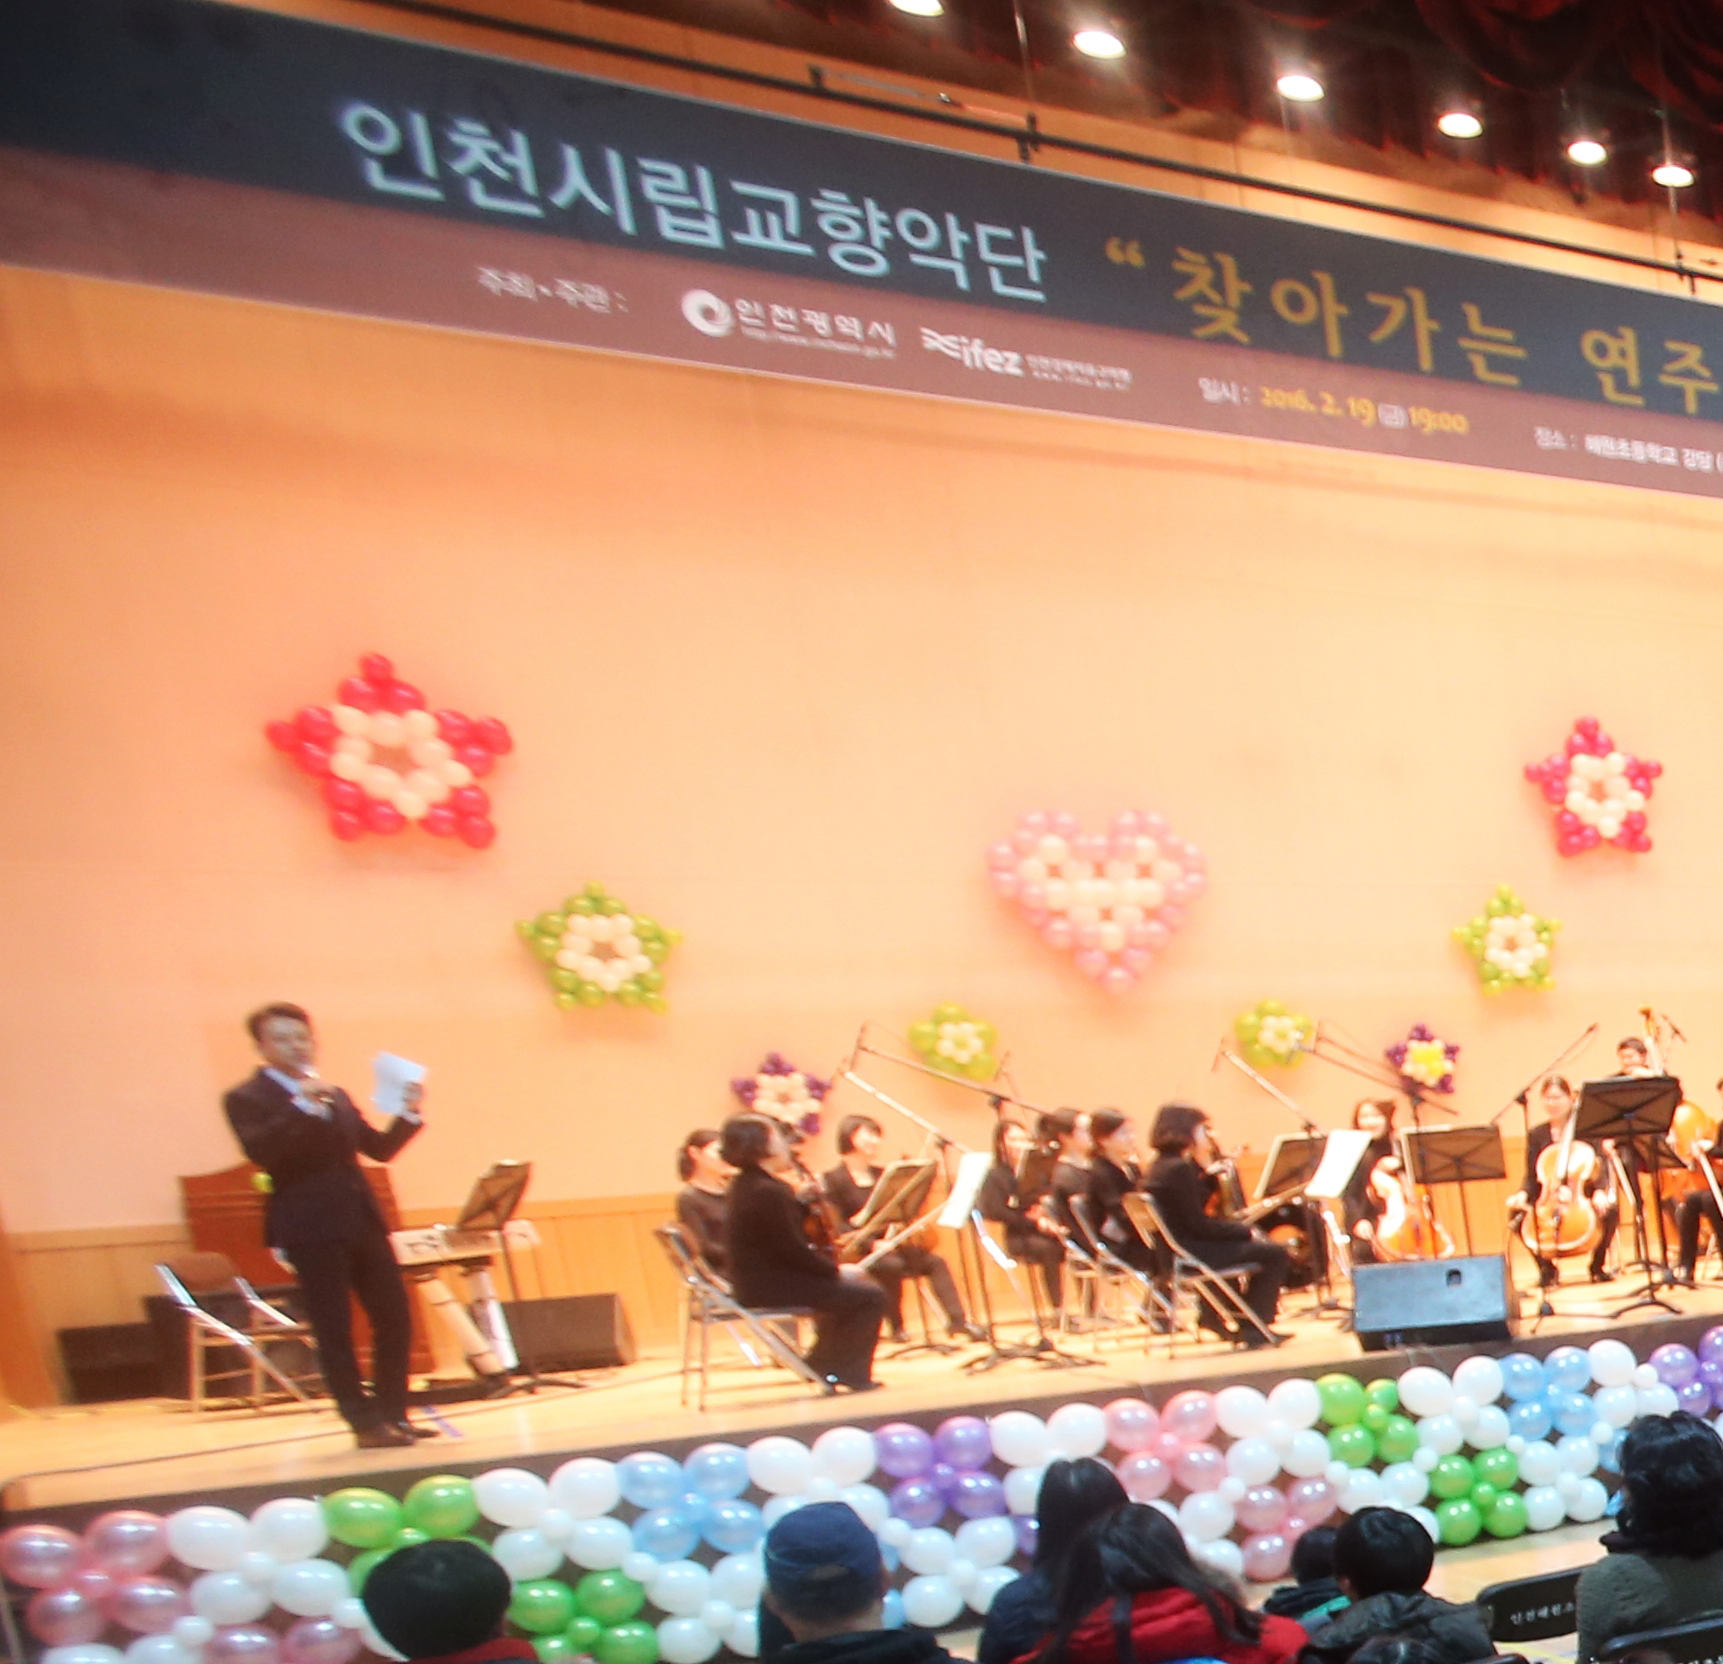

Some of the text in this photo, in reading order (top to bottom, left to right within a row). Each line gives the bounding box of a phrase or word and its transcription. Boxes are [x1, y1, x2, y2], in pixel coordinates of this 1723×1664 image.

[342, 102, 1047, 301] 인천시립교향악단
[735, 298, 897, 347] 인천광역시
[962, 334, 1024, 377] ifez
[1510, 1601, 1575, 1625] 인천해원초
